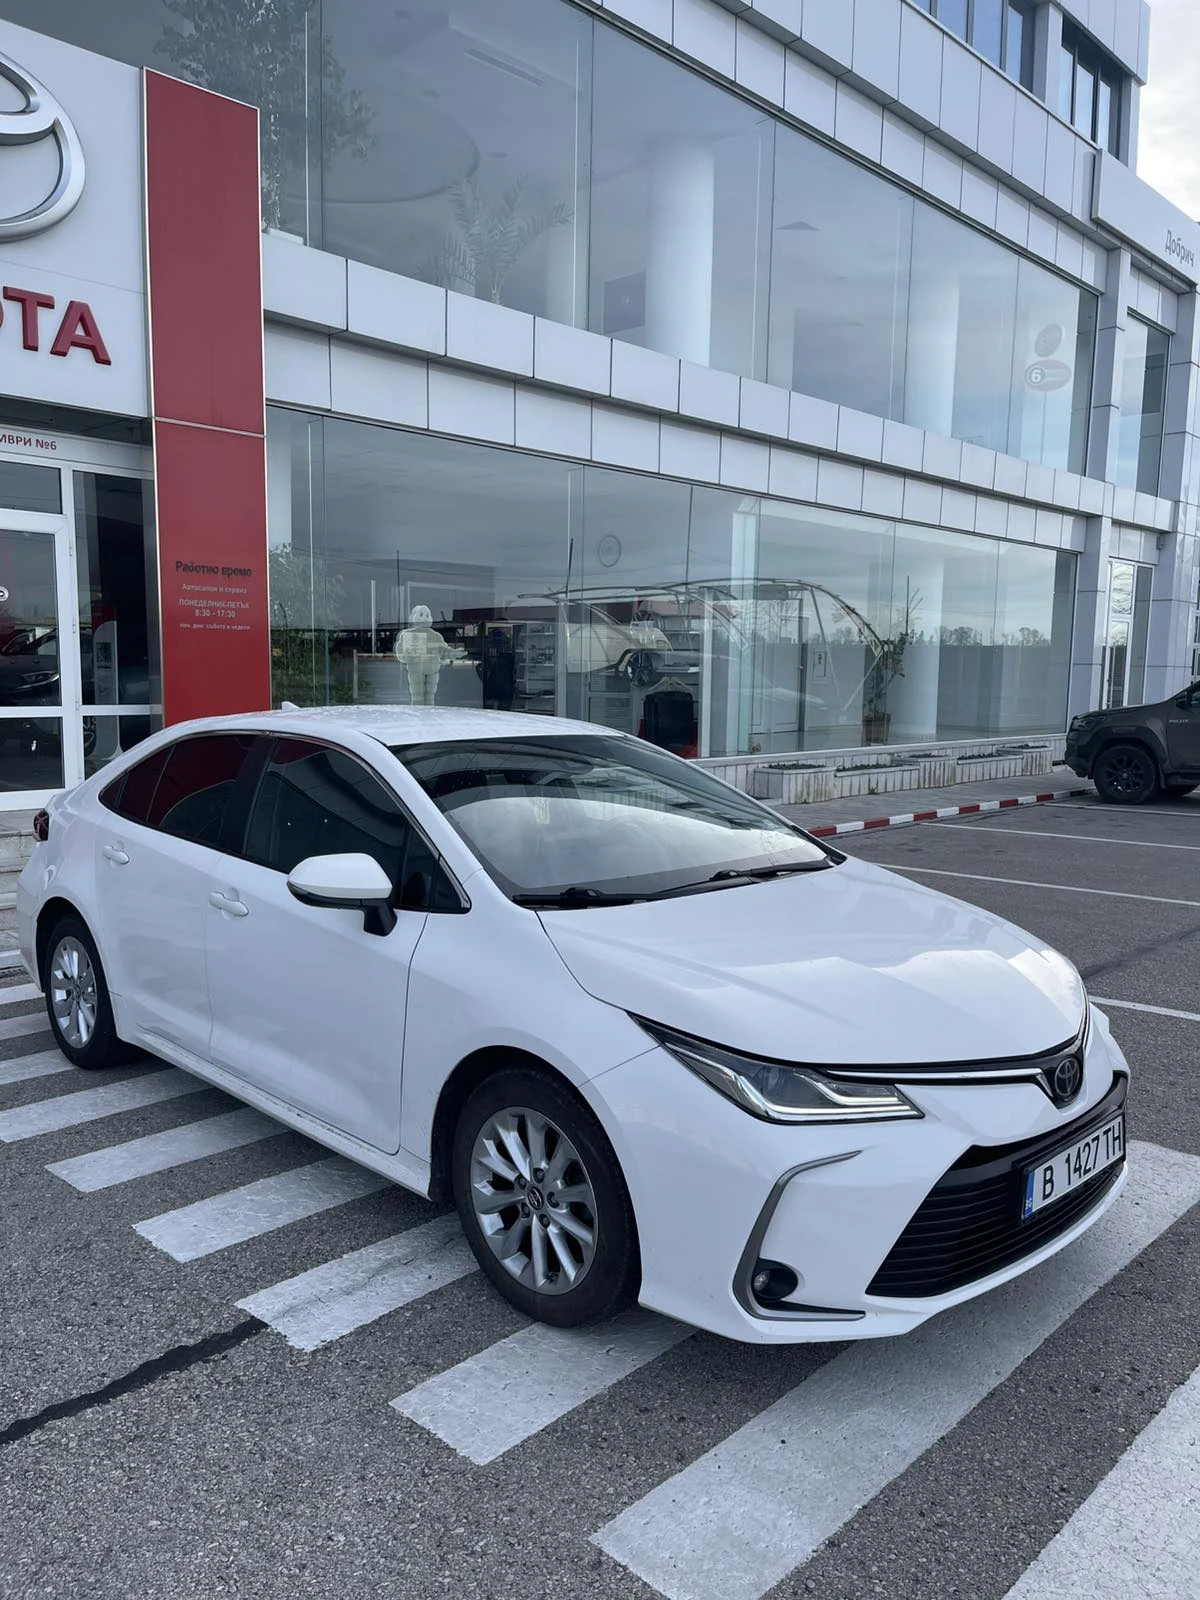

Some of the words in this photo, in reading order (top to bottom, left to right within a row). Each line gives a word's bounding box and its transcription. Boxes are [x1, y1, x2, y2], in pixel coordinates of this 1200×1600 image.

[1165, 229, 1195, 267] Добрич
[0, 286, 112, 366] TA
[35, 439, 57, 450] №6
[175, 560, 219, 574] Работно
[221, 566, 252, 578] време
[1042, 1164, 1055, 1201] B
[1065, 1134, 1100, 1186] 1427
[1103, 1121, 1121, 1160] TH
